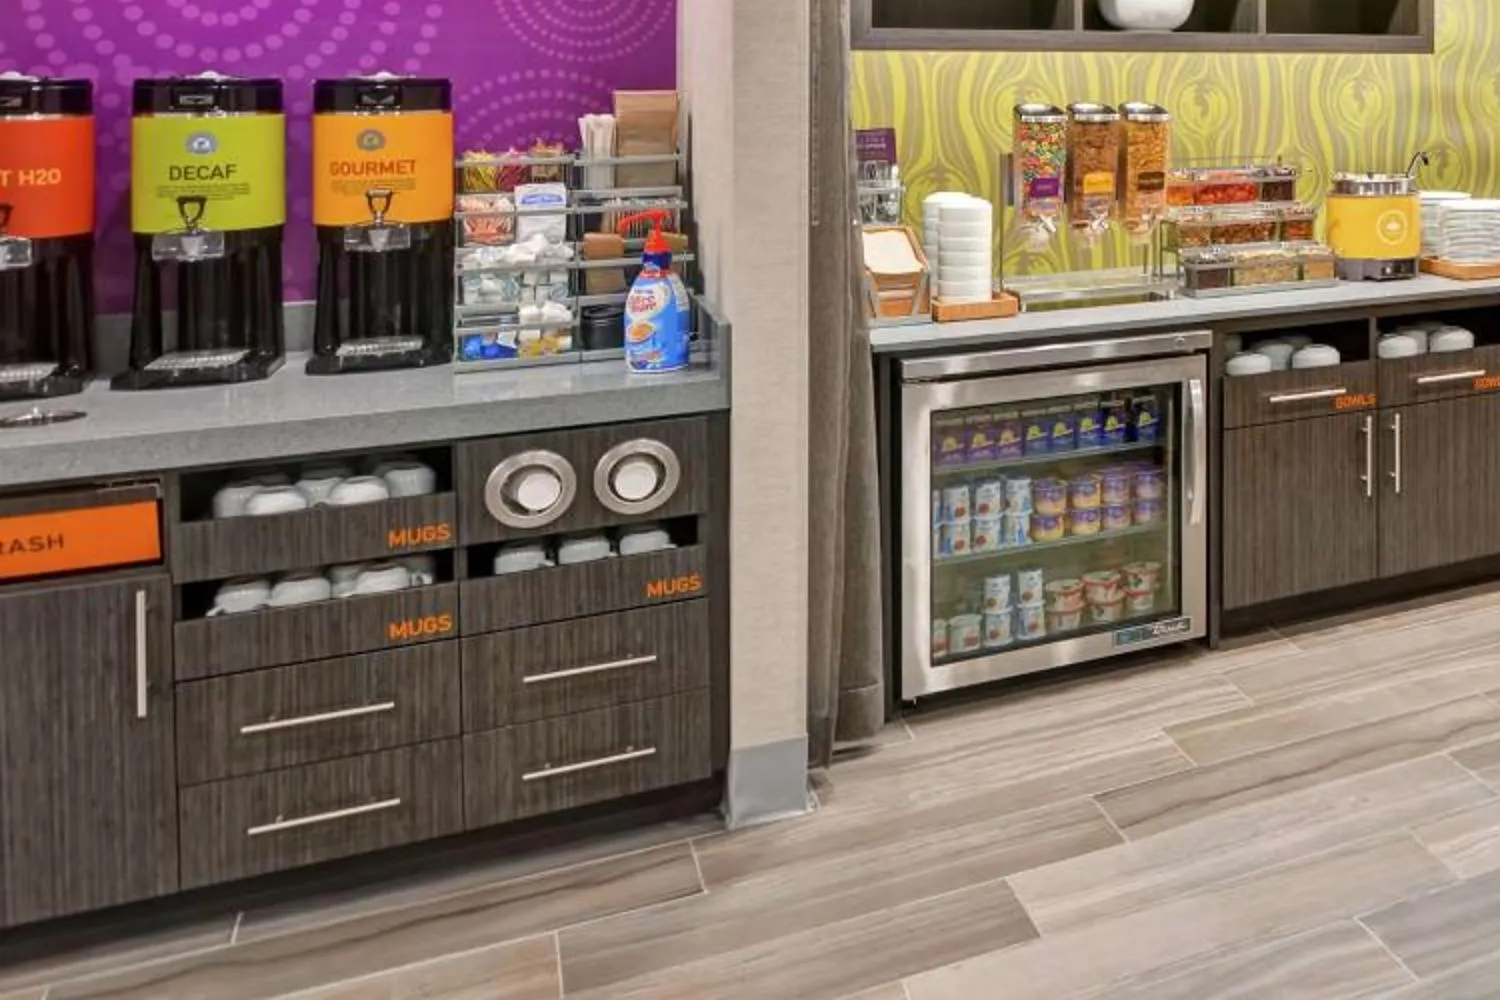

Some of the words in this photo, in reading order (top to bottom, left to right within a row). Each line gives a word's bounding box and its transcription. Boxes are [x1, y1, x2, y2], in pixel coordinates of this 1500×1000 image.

[168, 164, 237, 181] DECAF
[329, 159, 416, 177] GOURMET
[388, 523, 451, 547] MUGS
[647, 574, 702, 598] MUGS
[389, 614, 452, 639] MUGS
